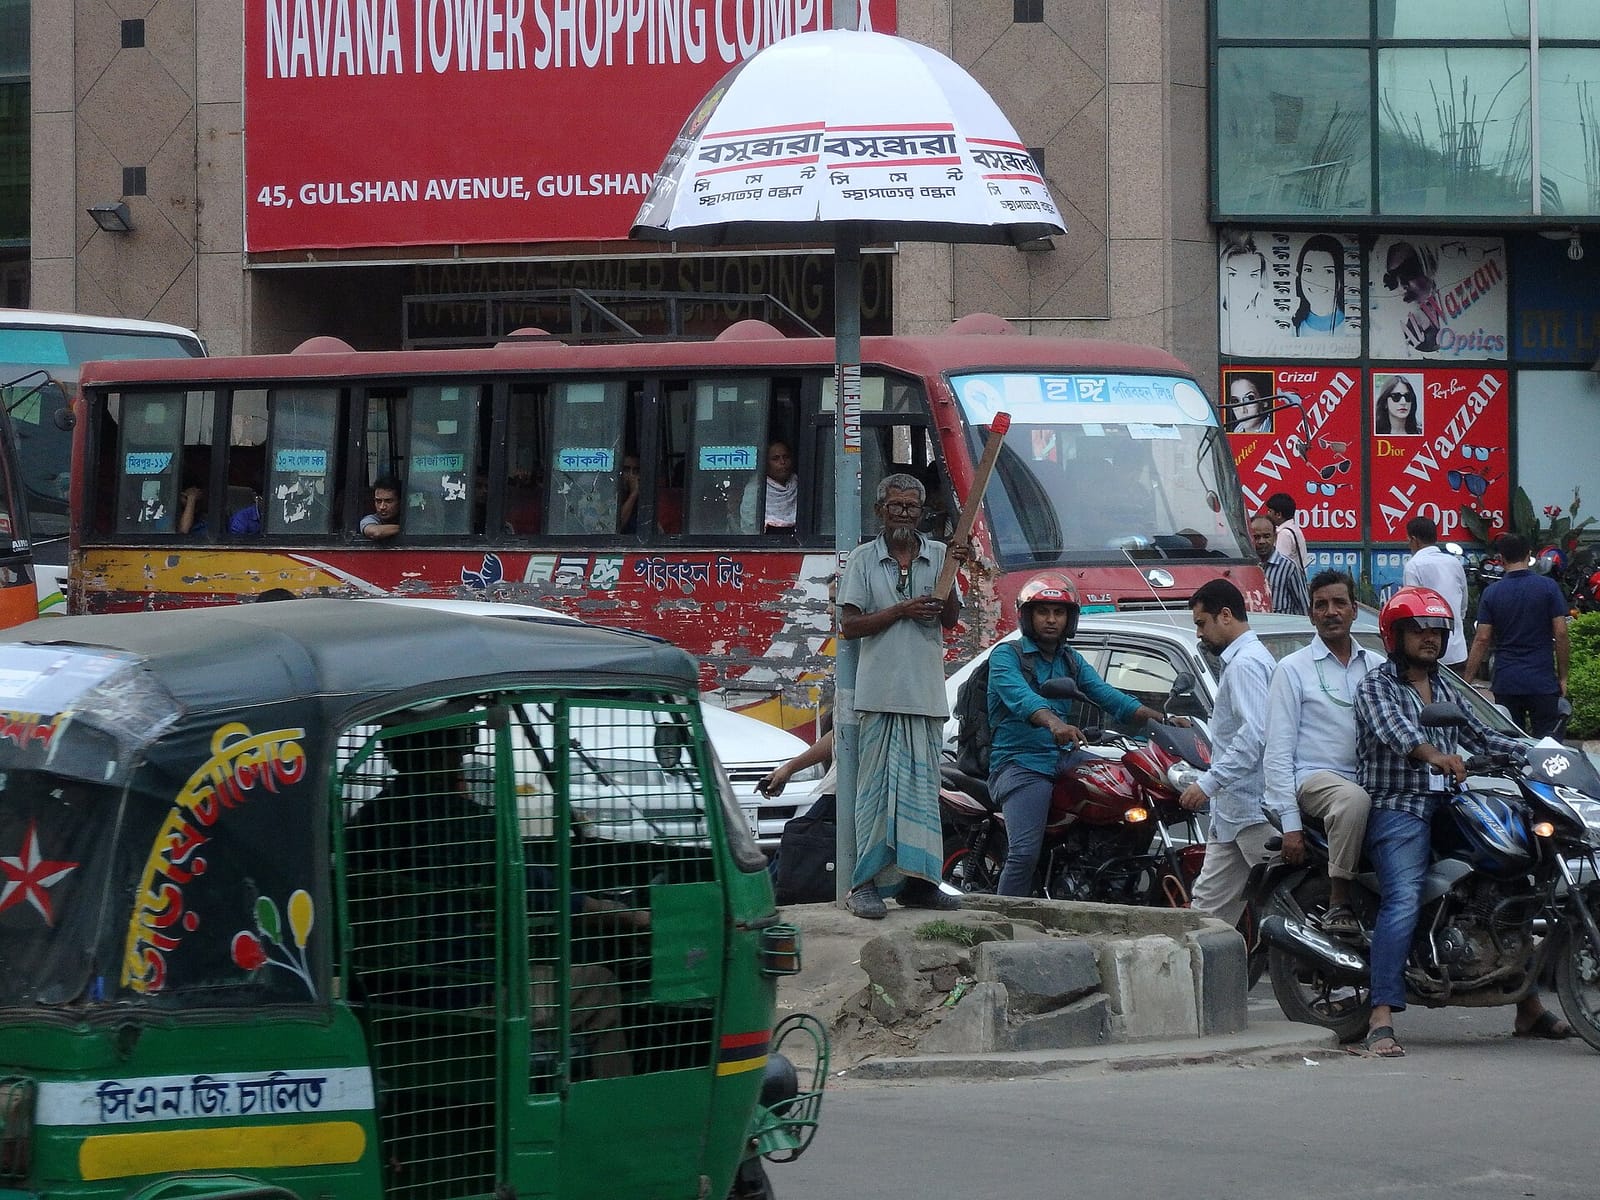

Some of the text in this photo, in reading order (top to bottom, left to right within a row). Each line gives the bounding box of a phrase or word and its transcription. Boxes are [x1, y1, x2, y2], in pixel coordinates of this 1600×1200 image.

[266, 0, 403, 78] NAVANA
[415, 0, 526, 73] TOWER
[533, 0, 706, 69] SHOPPING
[699, 133, 825, 163] বসুন্ধরা
[824, 134, 957, 158] বসুন্ধরা
[257, 173, 657, 209] 45, GULSHAN AVENUE, GULSHAN
[1436, 327, 1506, 355] Optics
[1278, 371, 1318, 384] Crizal
[562, 452, 610, 467] কাকলী
[705, 450, 751, 466] বনানী
[1376, 439, 1405, 457] Dior
[1378, 372, 1503, 534] Al-Wazzan
[1294, 502, 1357, 529] ptics
[237, 1071, 327, 1115] চালিত
